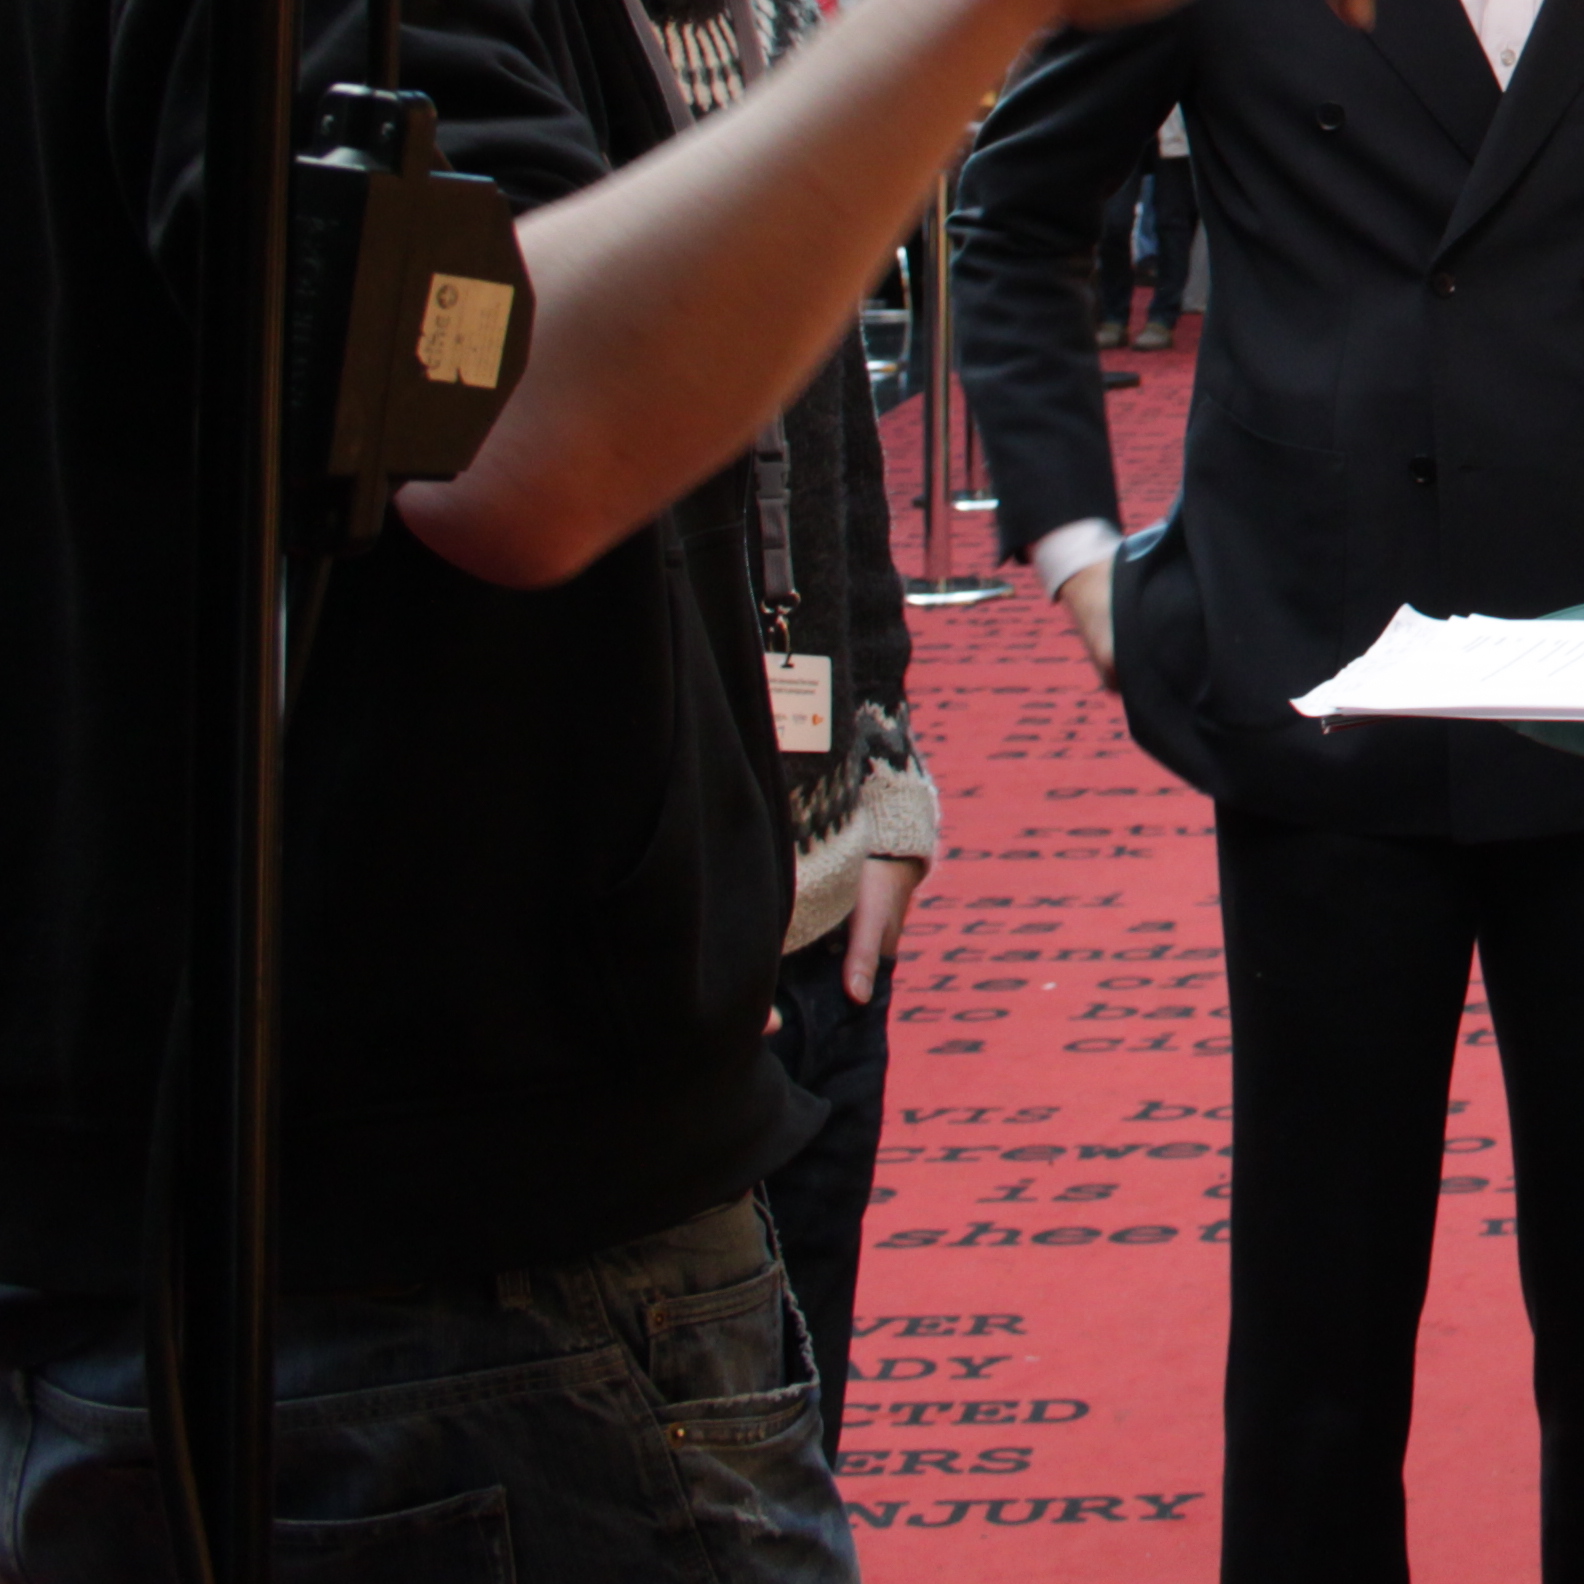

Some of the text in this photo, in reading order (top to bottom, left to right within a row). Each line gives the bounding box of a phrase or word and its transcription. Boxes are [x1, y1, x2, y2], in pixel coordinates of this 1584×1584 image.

[1015, 824, 1216, 838] retu
[944, 845, 1153, 861] back
[918, 892, 1124, 909] taxi
[1097, 970, 1225, 991] of
[1063, 1032, 1233, 1058] cig
[899, 1105, 1062, 1126] vis
[975, 1178, 1120, 1203] is
[851, 1313, 1028, 1338] VER
[841, 1398, 1091, 1429] CTED
[834, 1446, 1034, 1477] ERS
[844, 1492, 1206, 1529] NJURY
